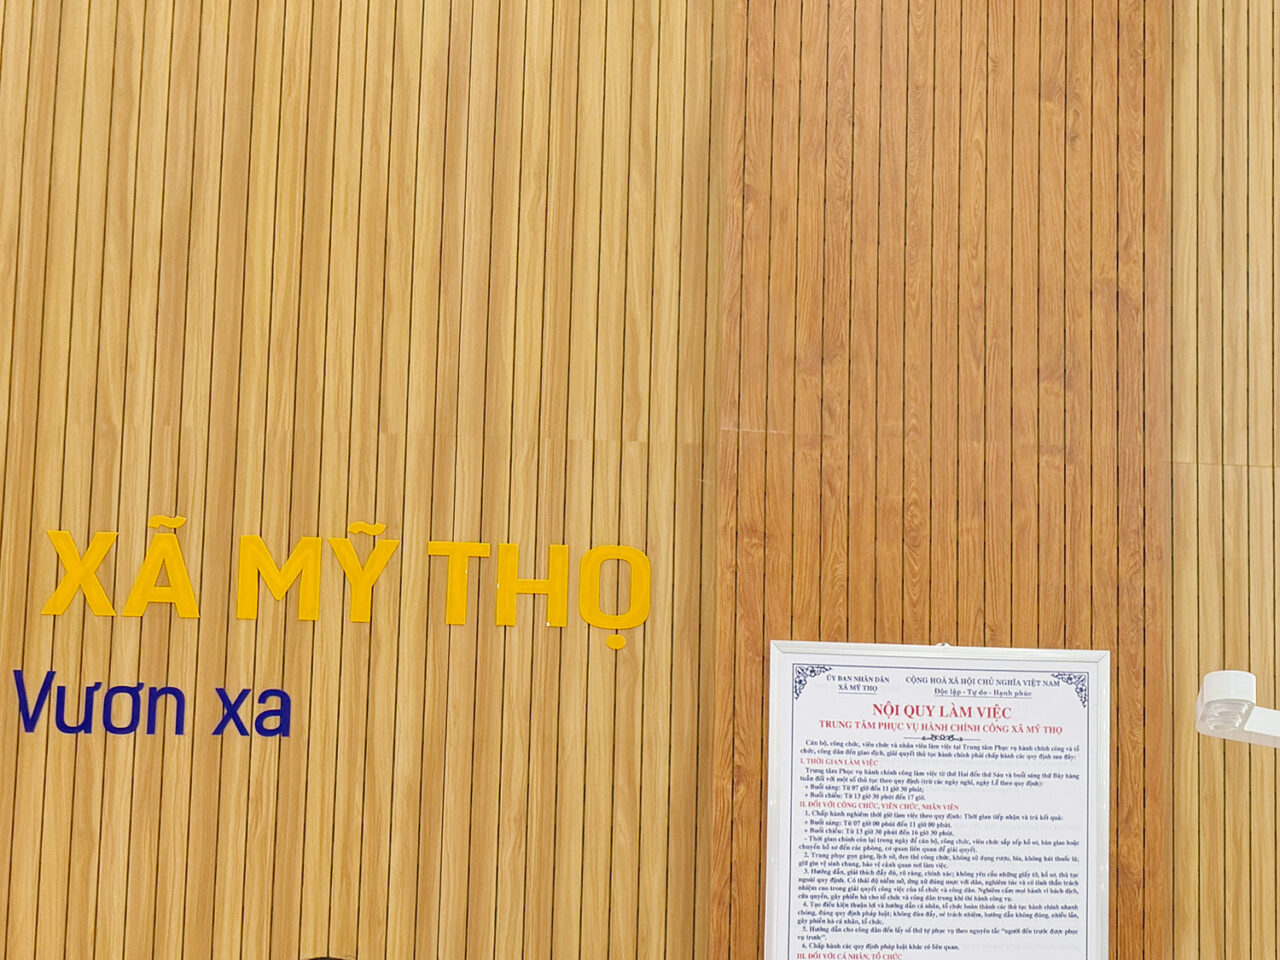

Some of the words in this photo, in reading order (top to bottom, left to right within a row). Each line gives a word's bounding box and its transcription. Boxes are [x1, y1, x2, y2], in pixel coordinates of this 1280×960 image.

[40, 514, 200, 619] XÃ
[236, 521, 400, 623] MỸ
[426, 541, 651, 650] THỌ
[905, 675, 928, 684] CỘNG
[948, 676, 959, 685] XÃ
[960, 677, 975, 686] HỘI
[996, 677, 1021, 686] NGHĨA
[1022, 678, 1041, 688] VIỆT
[12, 668, 186, 736] Vươn
[211, 685, 292, 738] xa
[873, 700, 900, 719] NỘI
[903, 704, 935, 719] QUY
[939, 703, 972, 719] LÀM
[977, 704, 1012, 722] VIỆC
[819, 720, 852, 729] TRUNG
[854, 719, 876, 729] TÂM
[878, 721, 904, 732] PHỤC
[905, 722, 919, 732] VỤ
[921, 721, 948, 731] HÀNH
[950, 722, 980, 732] CHÍNH
[982, 722, 1009, 734] CÔNG
[1012, 723, 1024, 733] XÃ
[1026, 723, 1040, 733] MỸ
[1043, 725, 1063, 735] THỌ
